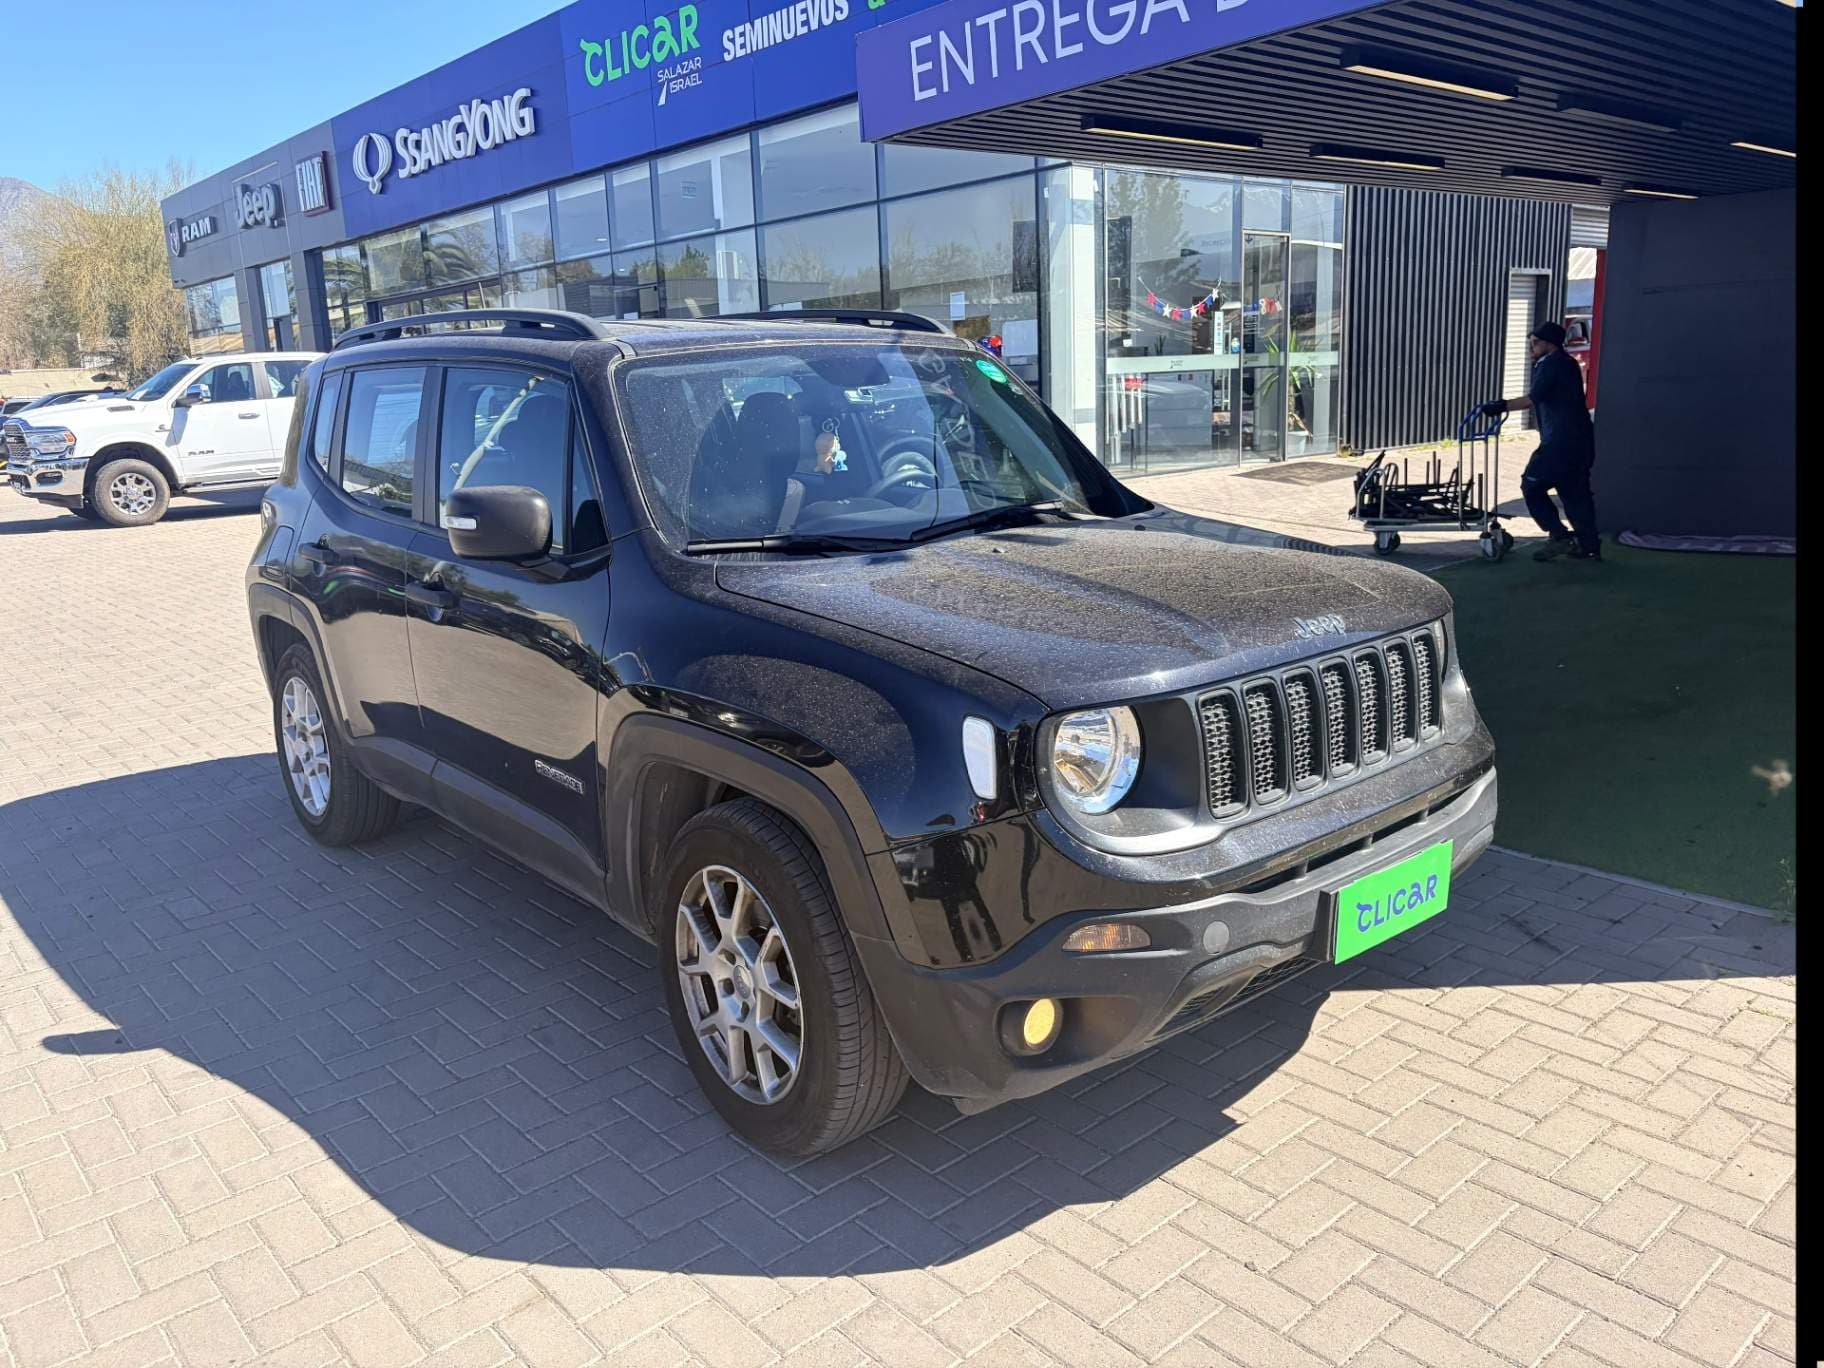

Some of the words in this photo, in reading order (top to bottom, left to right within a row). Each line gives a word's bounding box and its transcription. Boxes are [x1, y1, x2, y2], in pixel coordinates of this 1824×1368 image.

[722, 0, 850, 62] SEMINUEVOS
[910, 0, 1190, 101] ENTREGA
[657, 56, 702, 83] SALAZAR
[669, 72, 703, 94] ISRAEL
[295, 156, 326, 213] FIAT
[234, 183, 279, 229] Jeep
[181, 215, 213, 243] RAM
[1293, 614, 1345, 640] Jeep
